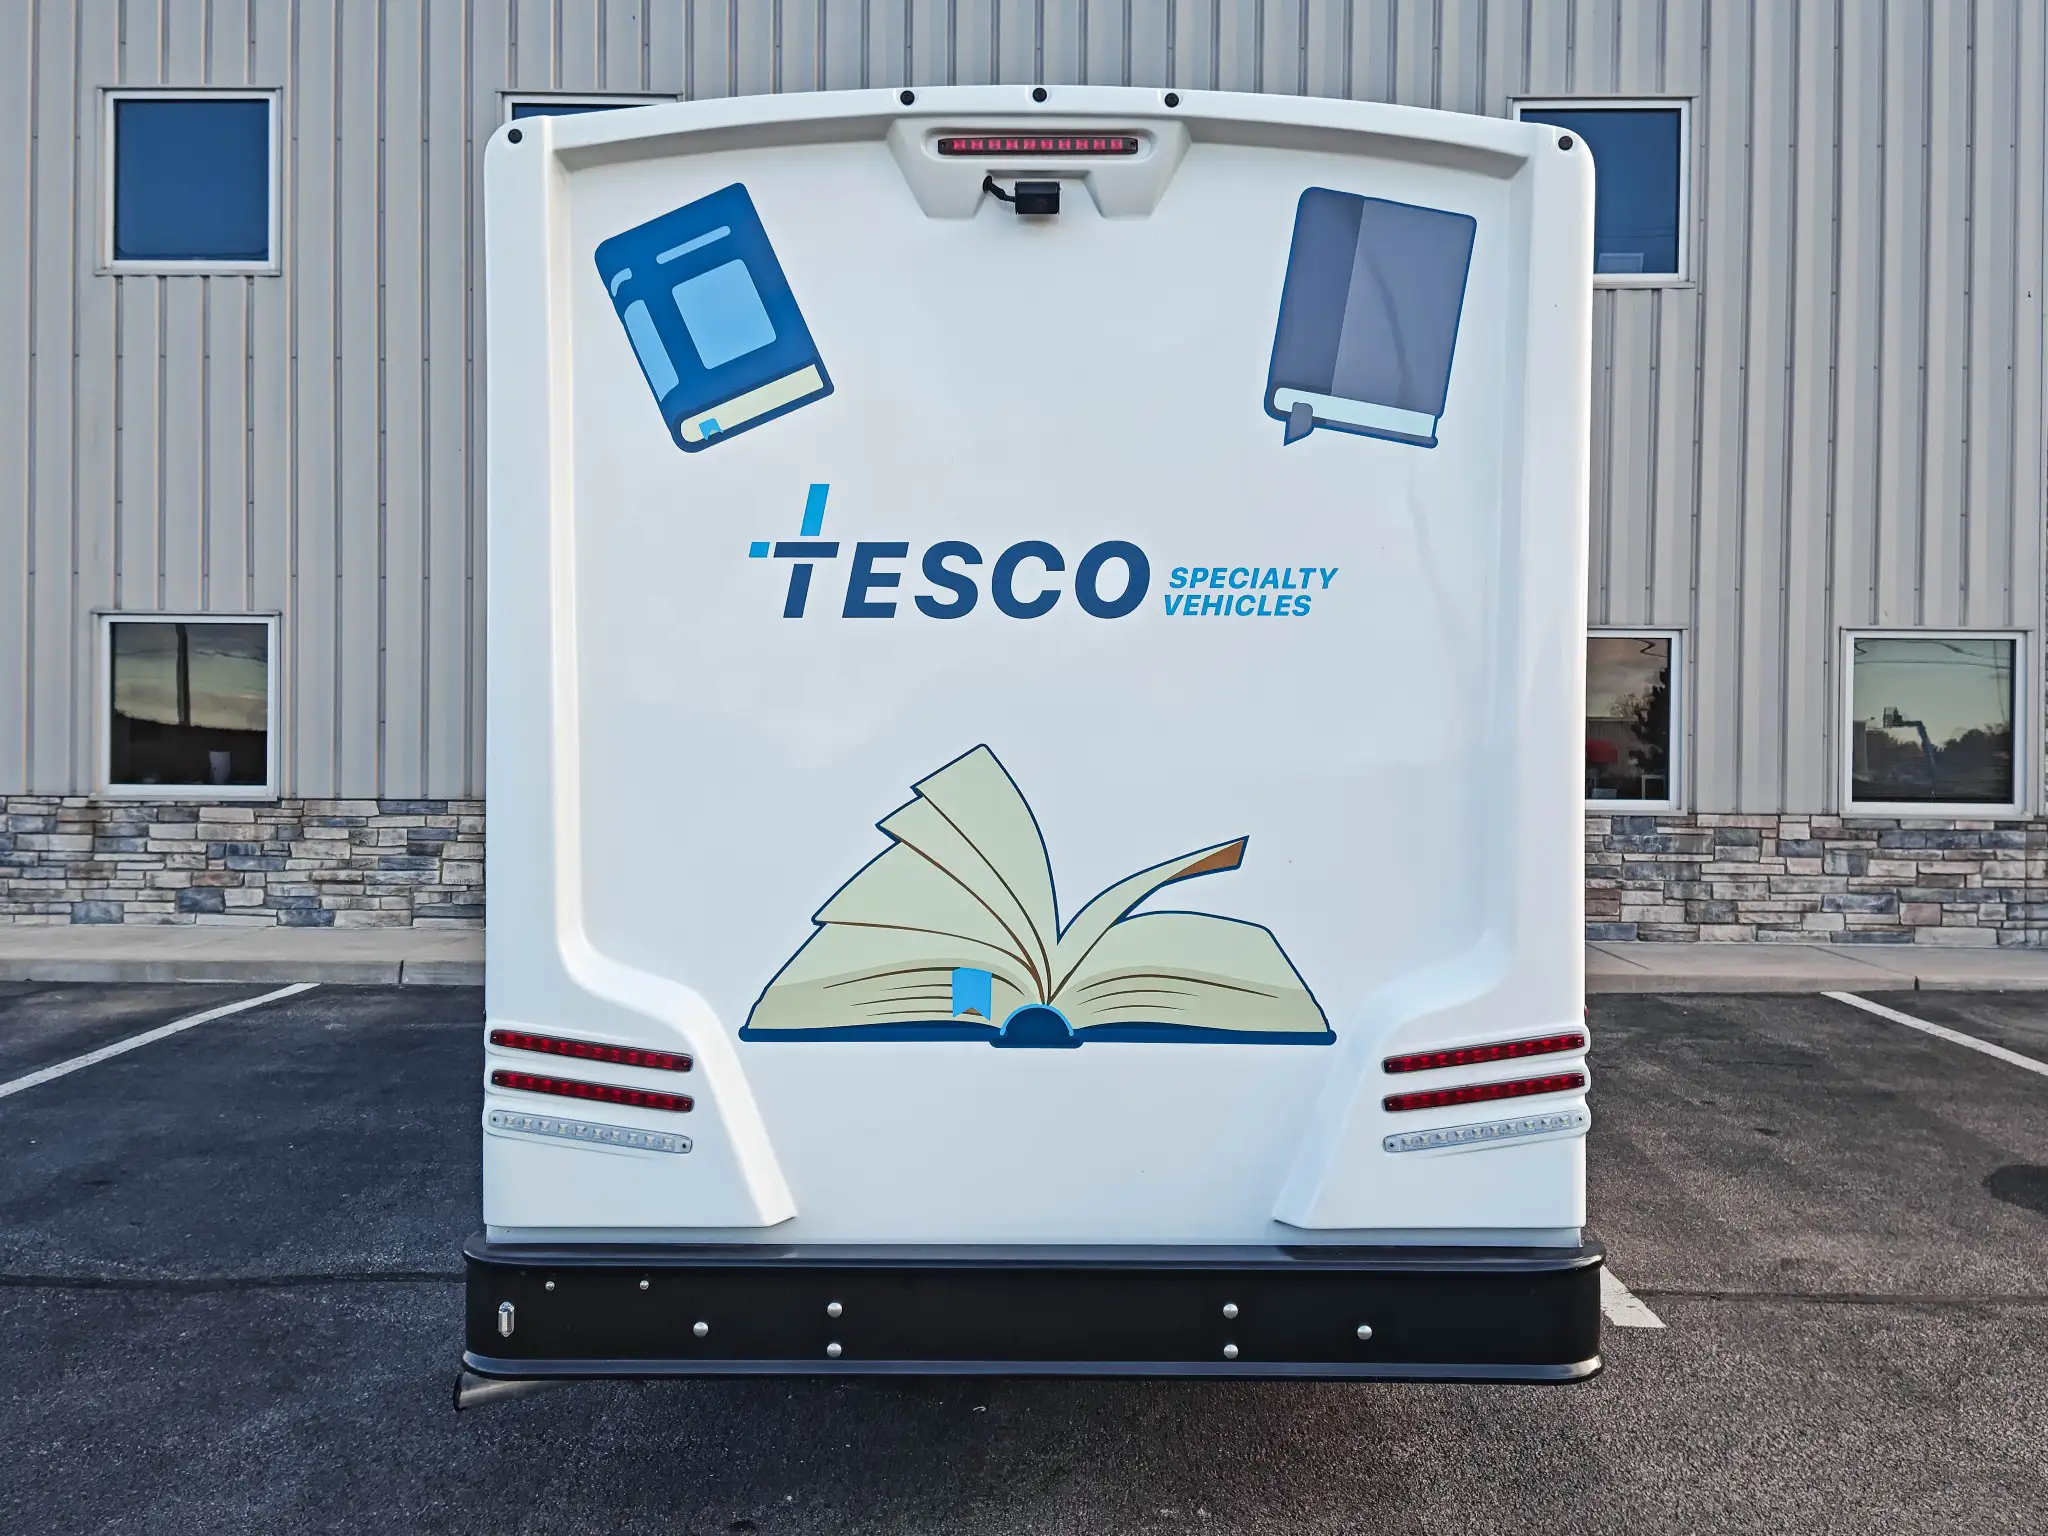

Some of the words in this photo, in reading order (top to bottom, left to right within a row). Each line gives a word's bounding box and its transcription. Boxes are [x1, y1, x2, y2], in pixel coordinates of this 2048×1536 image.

[749, 484, 1151, 620] TESCO
[1169, 566, 1339, 590] SPECIALTY
[1164, 594, 1312, 617] VEHICLES
